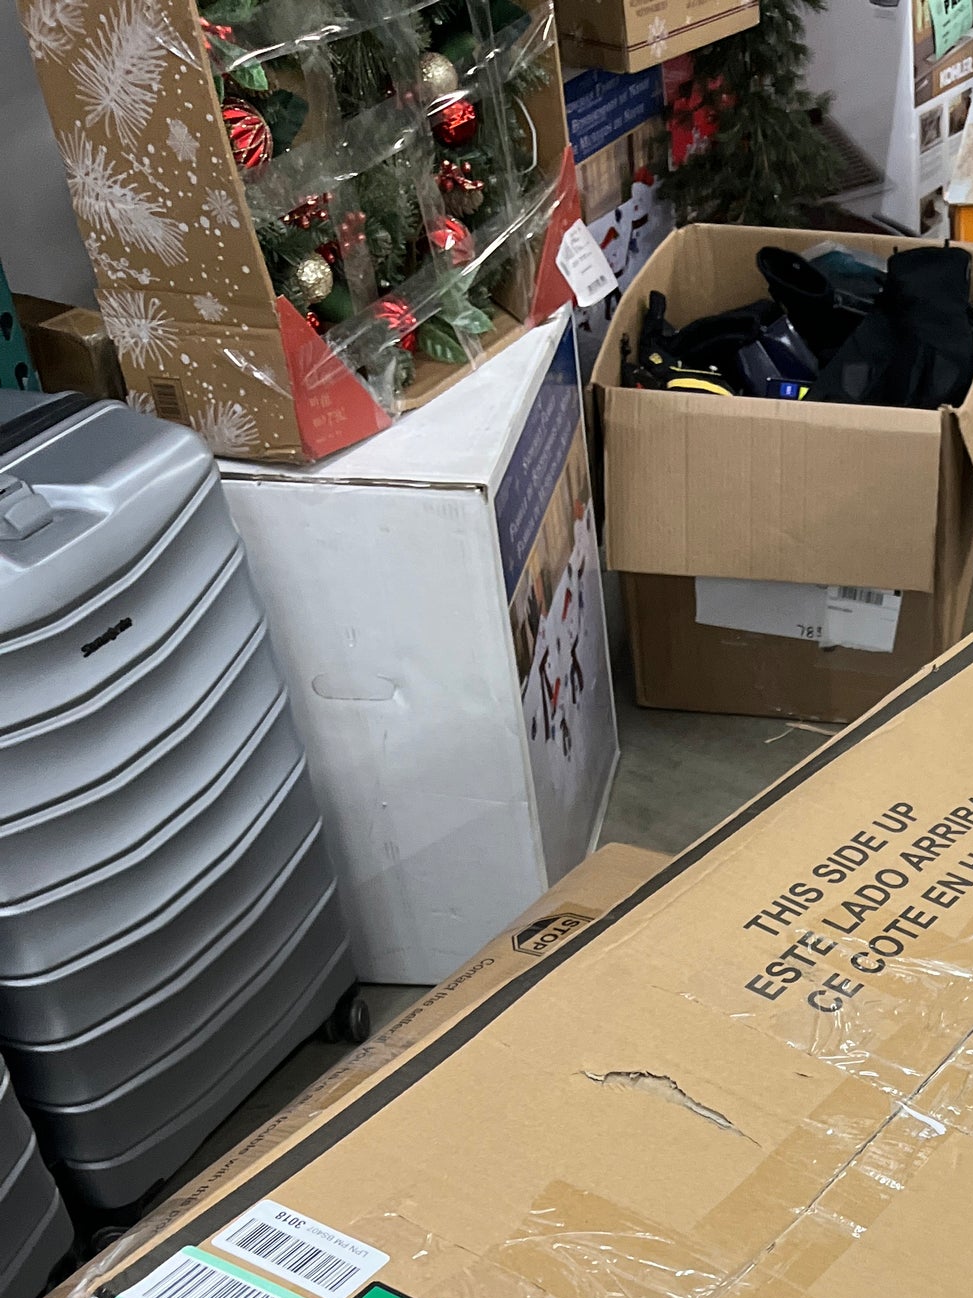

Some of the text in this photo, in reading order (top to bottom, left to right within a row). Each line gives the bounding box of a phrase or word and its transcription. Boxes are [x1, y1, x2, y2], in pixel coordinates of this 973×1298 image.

[743, 802, 918, 936] THIS SIDE UP
[533, 918, 581, 951] STOP
[744, 930, 839, 1001] ESTE
[821, 868, 910, 935] LADO
[448, 957, 496, 992] Contact
[807, 972, 865, 1013] CE
[850, 905, 939, 974] COTE
[422, 991, 449, 1008] the
[238, 1114, 289, 1156] trouble
[208, 1156, 238, 1183] with
[179, 1183, 210, 1208] this
[274, 1210, 306, 1230] 3018
